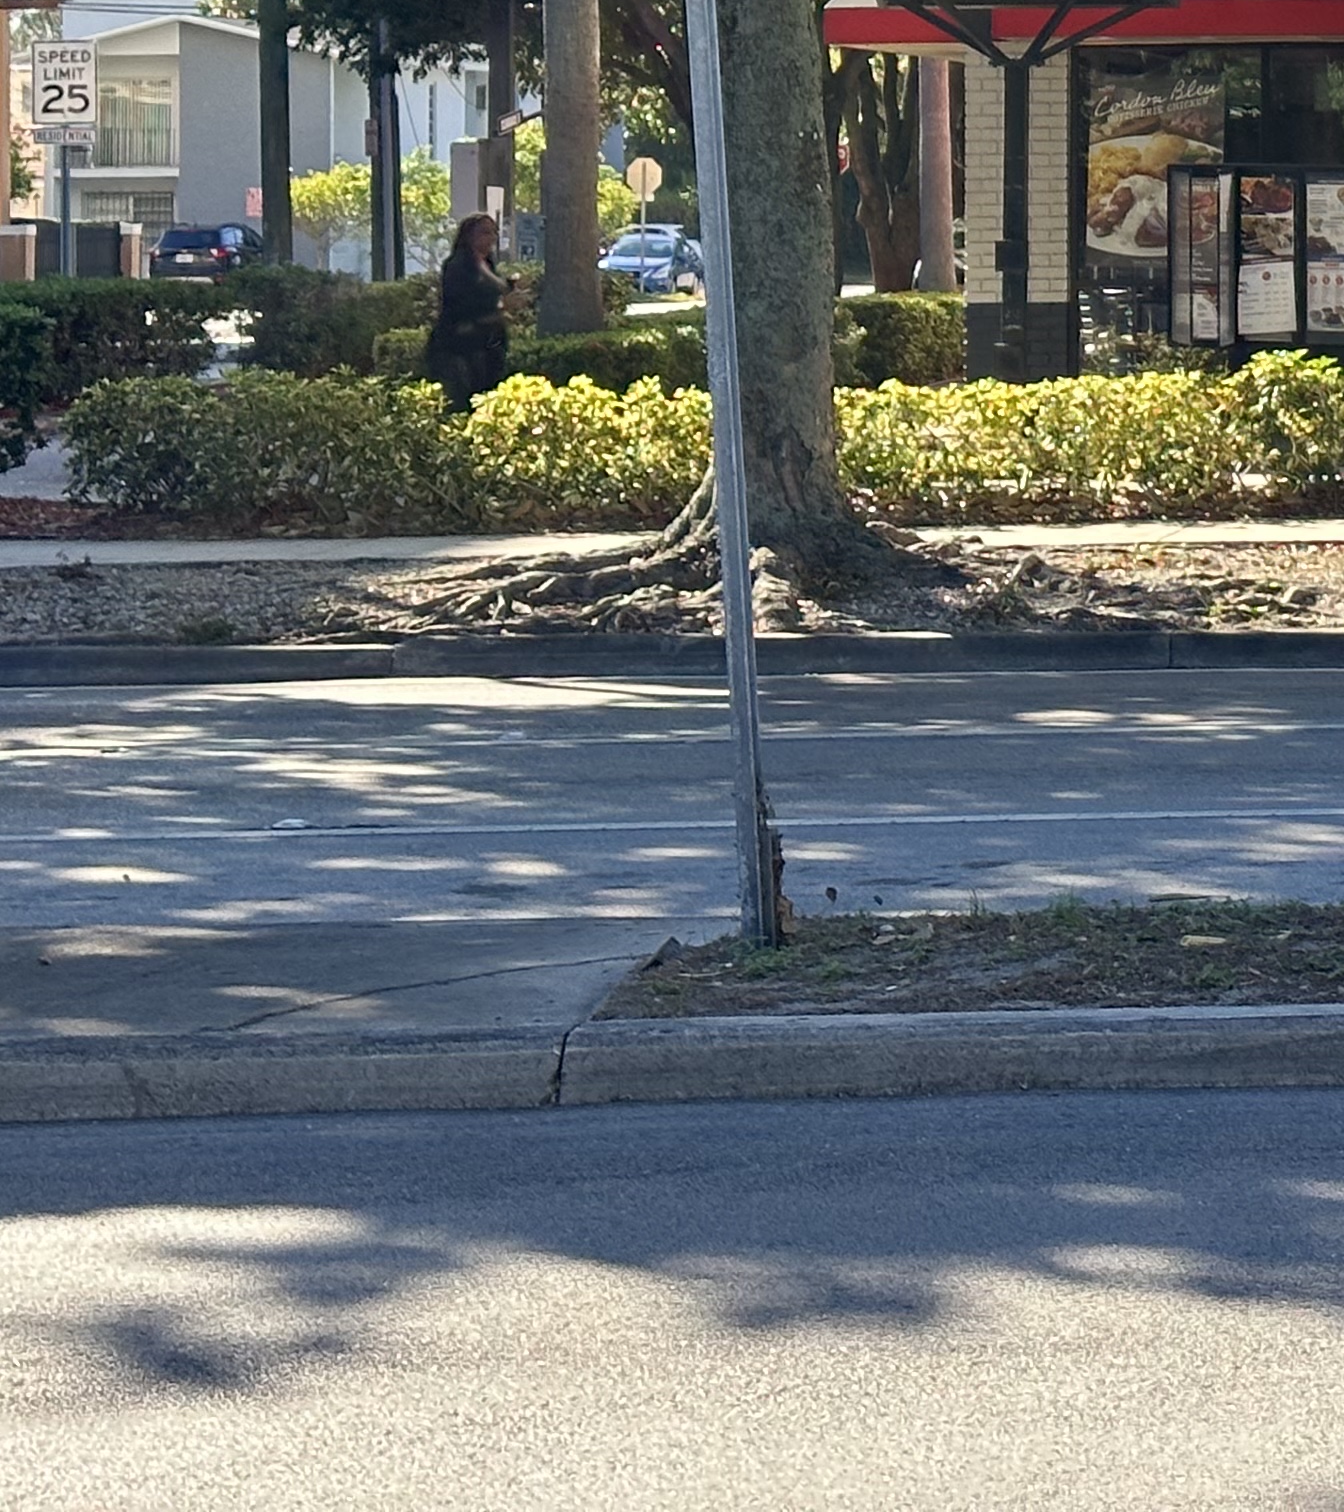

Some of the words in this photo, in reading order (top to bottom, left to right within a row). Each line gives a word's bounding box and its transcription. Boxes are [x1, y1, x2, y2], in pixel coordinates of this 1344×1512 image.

[37, 49, 92, 64] SPEED
[43, 67, 86, 81] LIMIT
[41, 84, 90, 114] 25
[1094, 91, 1166, 117] Cordon
[1170, 78, 1221, 100] Bleu
